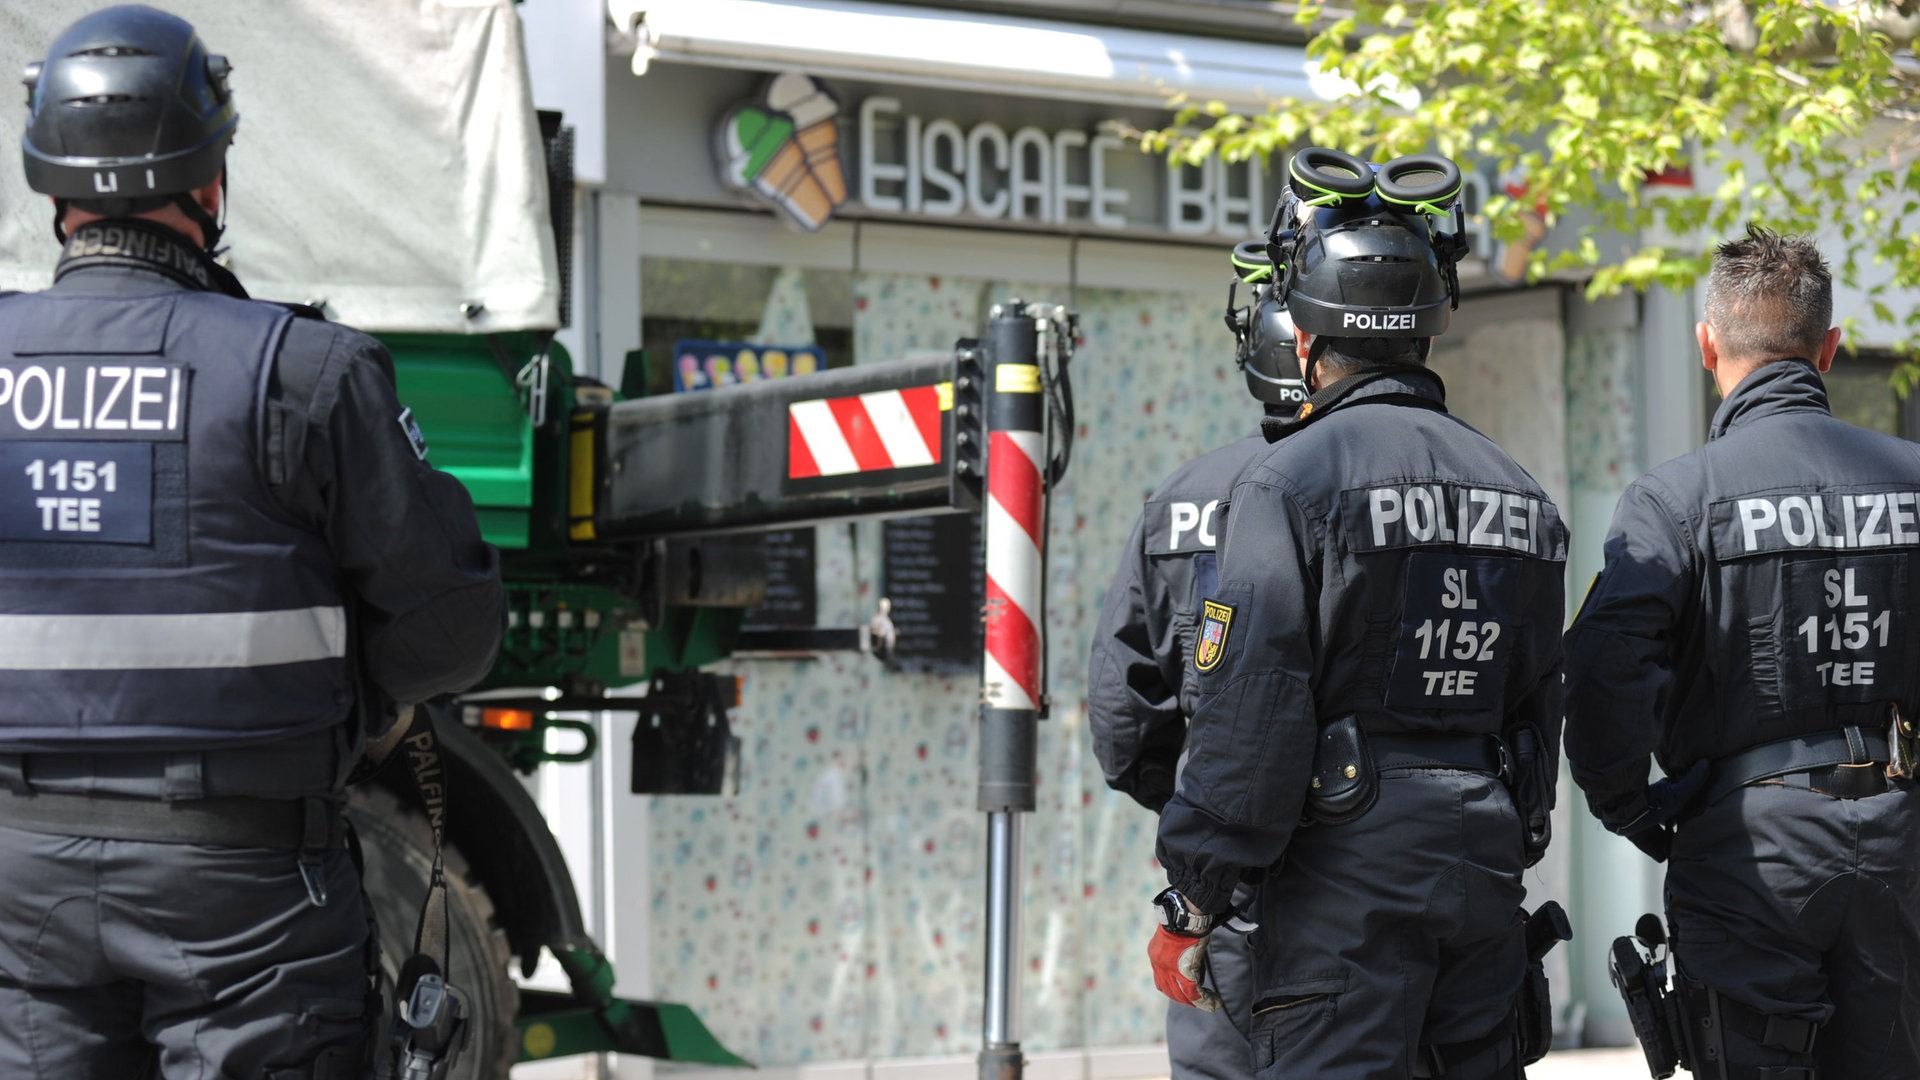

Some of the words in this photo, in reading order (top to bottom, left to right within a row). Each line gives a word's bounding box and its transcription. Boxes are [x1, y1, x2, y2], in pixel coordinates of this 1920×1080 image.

[1343, 312, 1416, 330] POLIZEI
[25, 459, 117, 492] 1151
[36, 497, 101, 532] TEE
[1368, 485, 1539, 554] POLIZEI
[1441, 567, 1478, 610] SL
[1823, 567, 1868, 609] SL
[1205, 605, 1230, 623] POLIZEI
[1798, 610, 1891, 653] 1151
[1414, 618, 1501, 662] 1152
[1422, 670, 1479, 696] TEE
[1815, 661, 1876, 687] TEE
